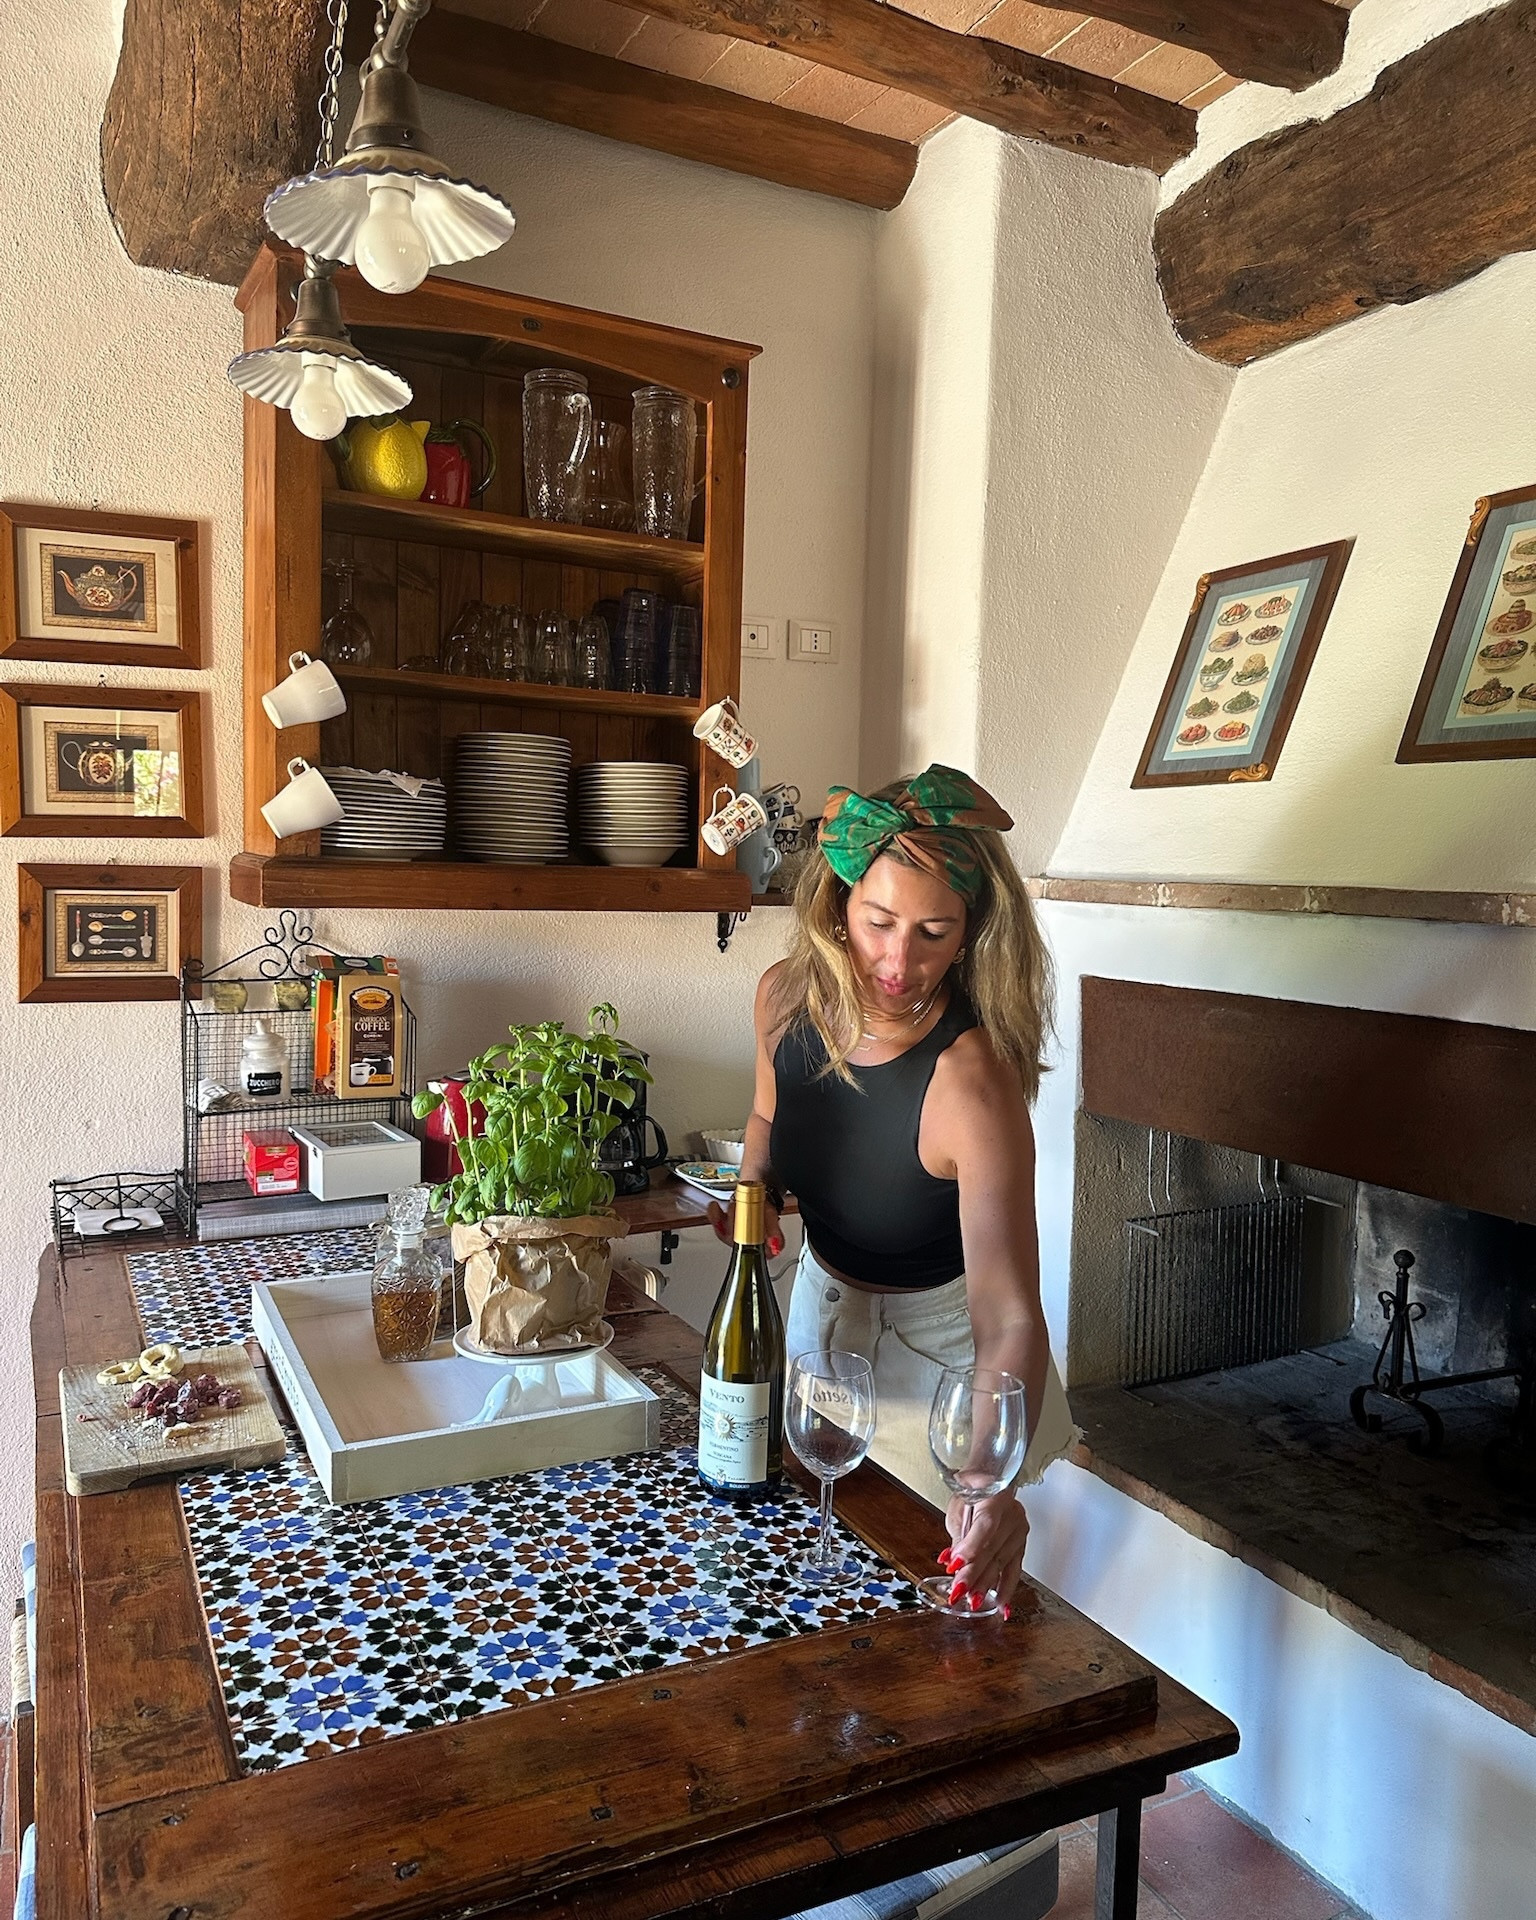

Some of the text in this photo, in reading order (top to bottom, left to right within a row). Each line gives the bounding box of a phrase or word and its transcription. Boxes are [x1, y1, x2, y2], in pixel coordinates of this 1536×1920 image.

[359, 1015, 387, 1024] AMERICAN
[354, 1021, 391, 1032] COFFEE
[249, 1078, 280, 1087] ZUCCHERO
[709, 1388, 745, 1404] VENTO
